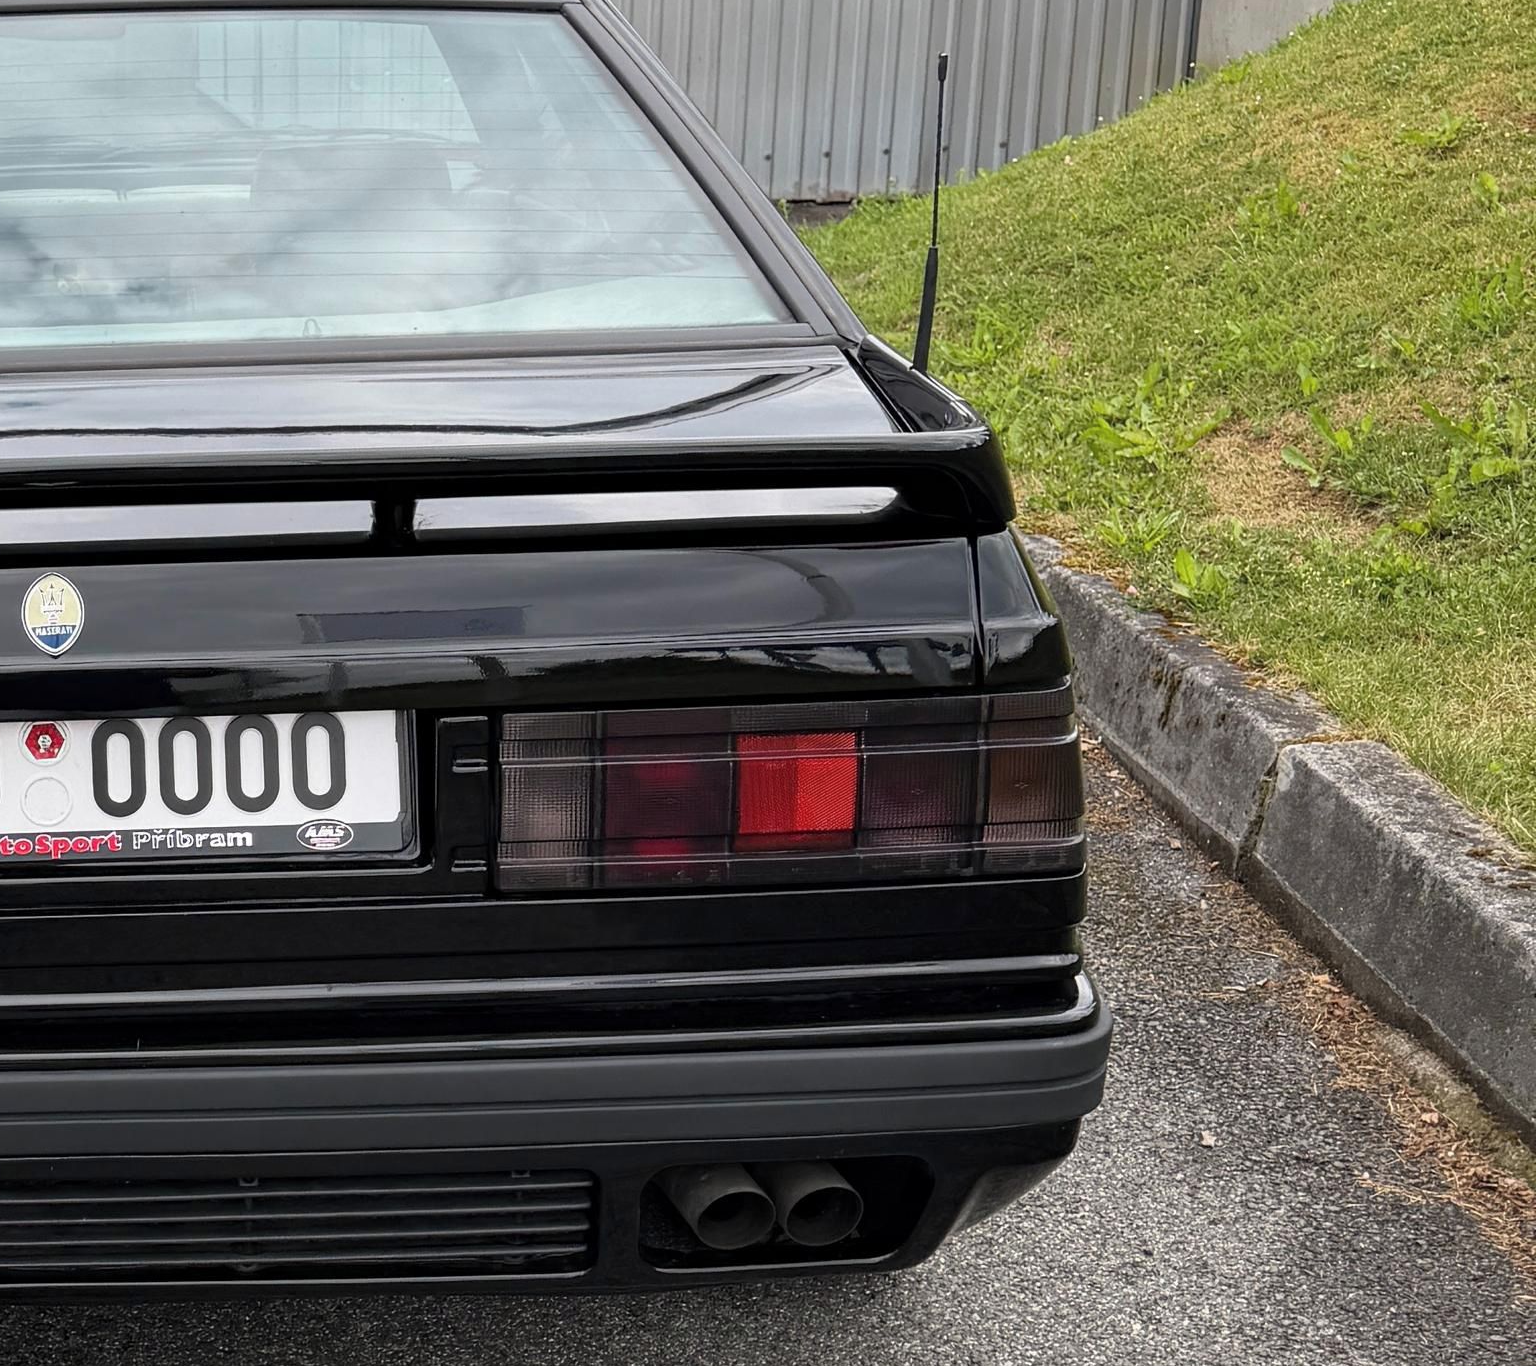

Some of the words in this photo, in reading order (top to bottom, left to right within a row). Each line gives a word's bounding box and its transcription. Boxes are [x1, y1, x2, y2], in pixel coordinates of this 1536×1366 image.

[35, 626, 73, 636] MASERATI
[90, 711, 347, 818] 0000
[132, 827, 254, 850] Příbram
[305, 825, 346, 838] AMS
